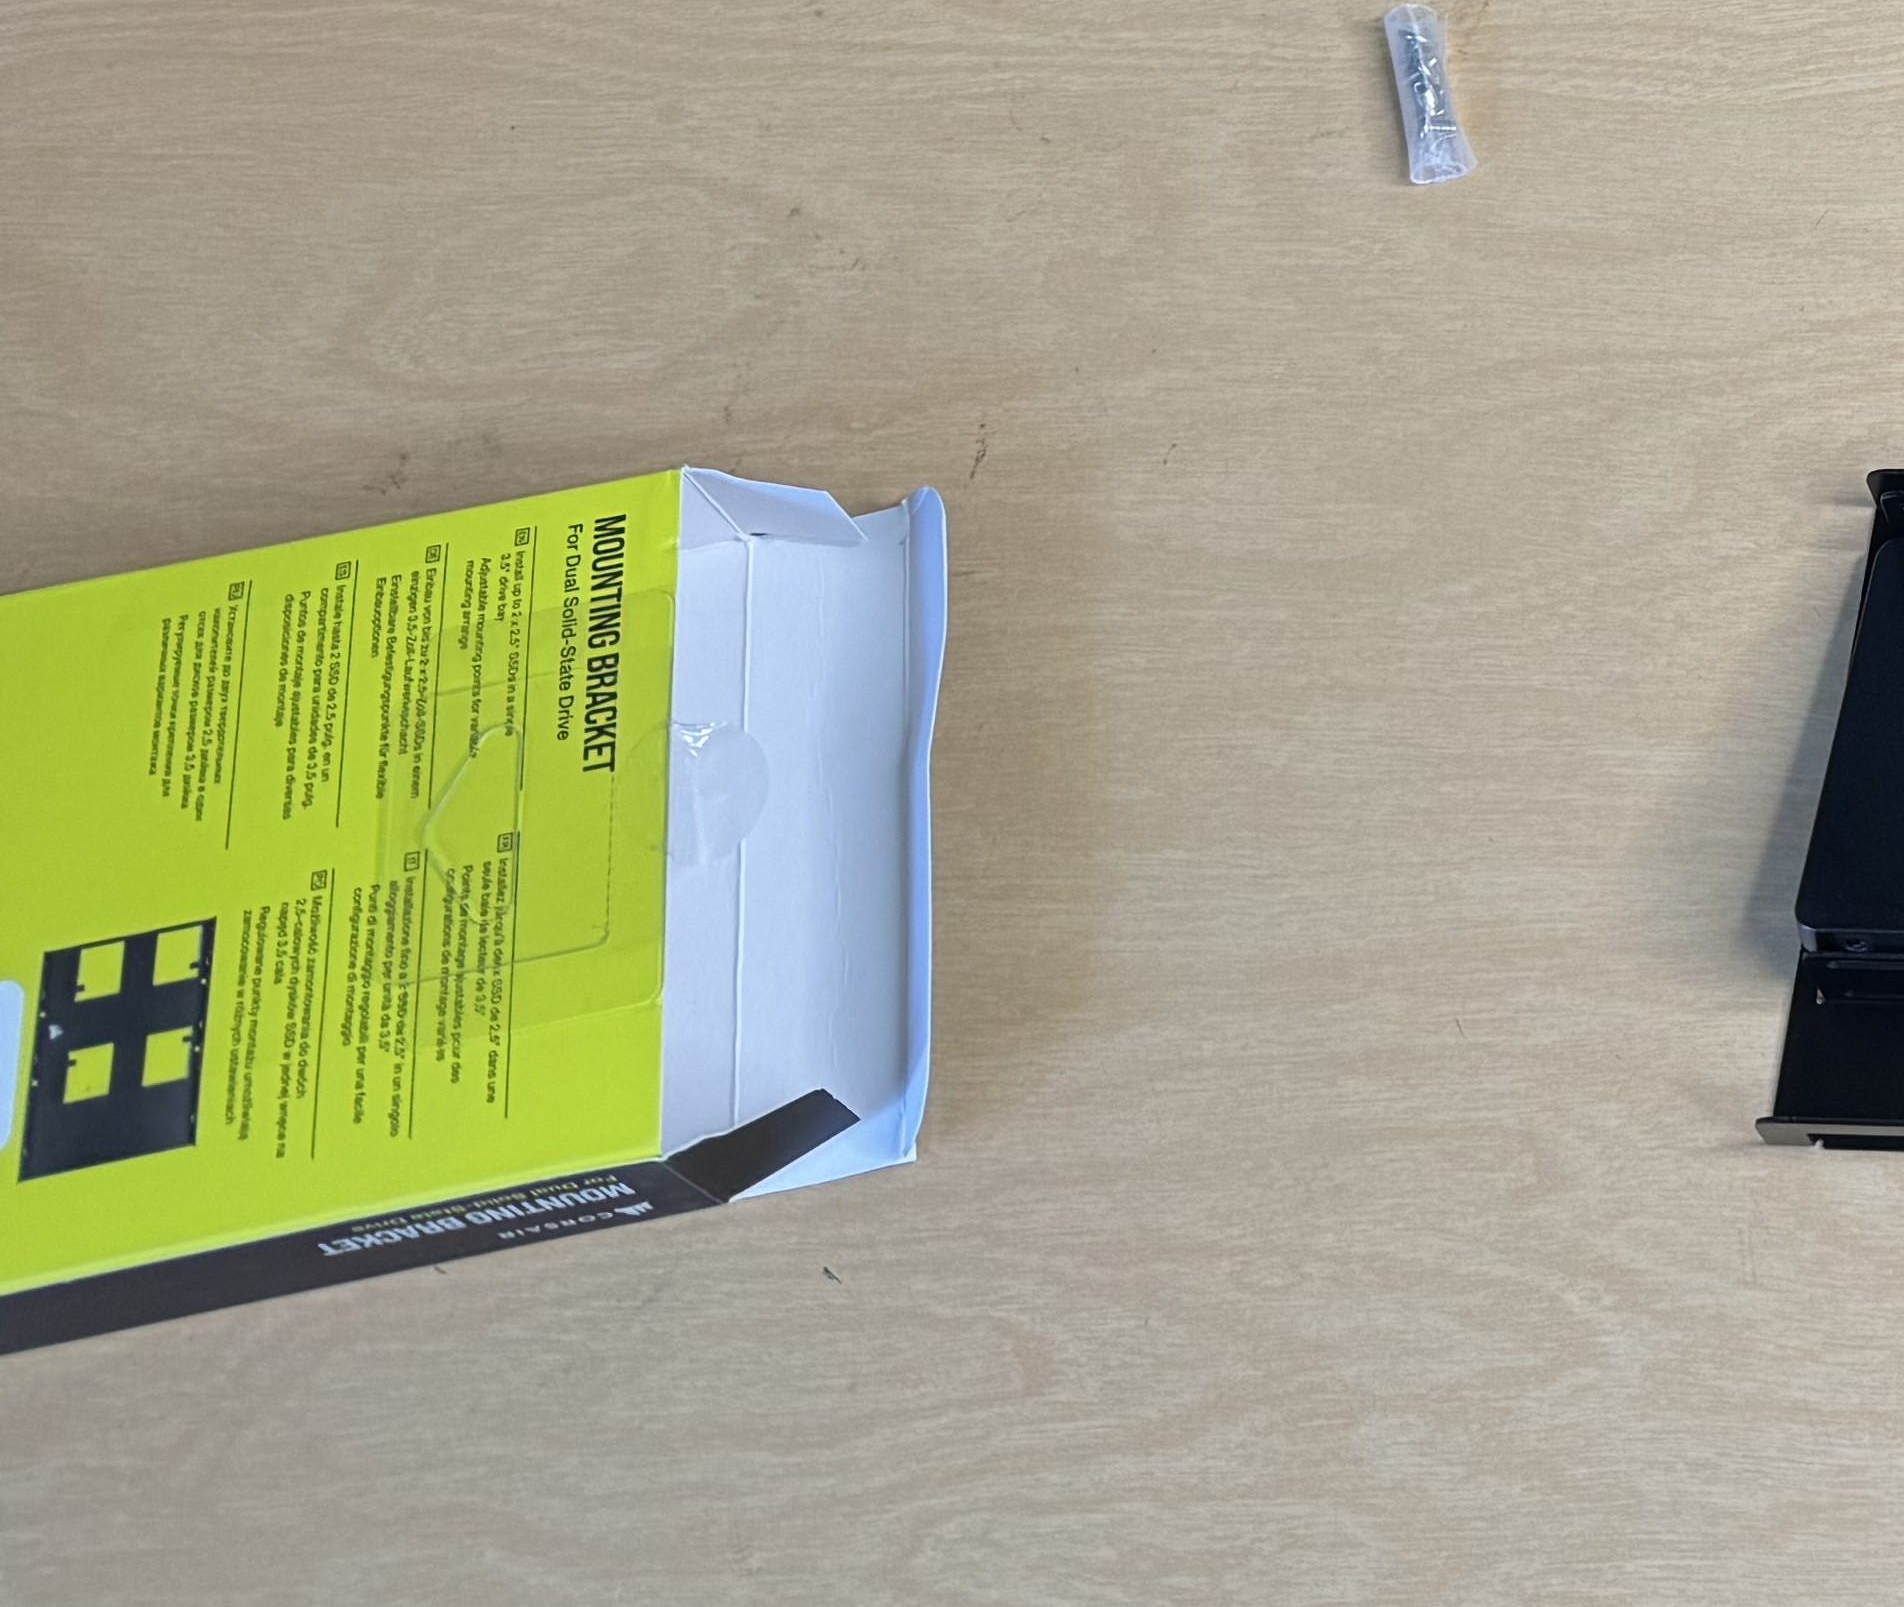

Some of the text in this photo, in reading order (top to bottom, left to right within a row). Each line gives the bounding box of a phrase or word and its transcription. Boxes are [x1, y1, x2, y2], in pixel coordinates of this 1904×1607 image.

[514, 550, 525, 581] Install
[460, 560, 474, 608] mounting
[478, 557, 491, 611] Adjustable
[498, 576, 508, 601] drive
[494, 602, 507, 621] bay
[472, 613, 485, 662] mounting
[557, 523, 583, 740] For Dual Solid-State Drive
[583, 515, 625, 771] MOUNTING BRACKET
[312, 668, 322, 693] para
[471, 698, 482, 713] for
[487, 1049, 498, 1079] dans
[486, 1081, 495, 1103] une
[320, 1183, 632, 1255] MOUNTING BRACKET
[499, 1212, 612, 1238] CORSAIR
